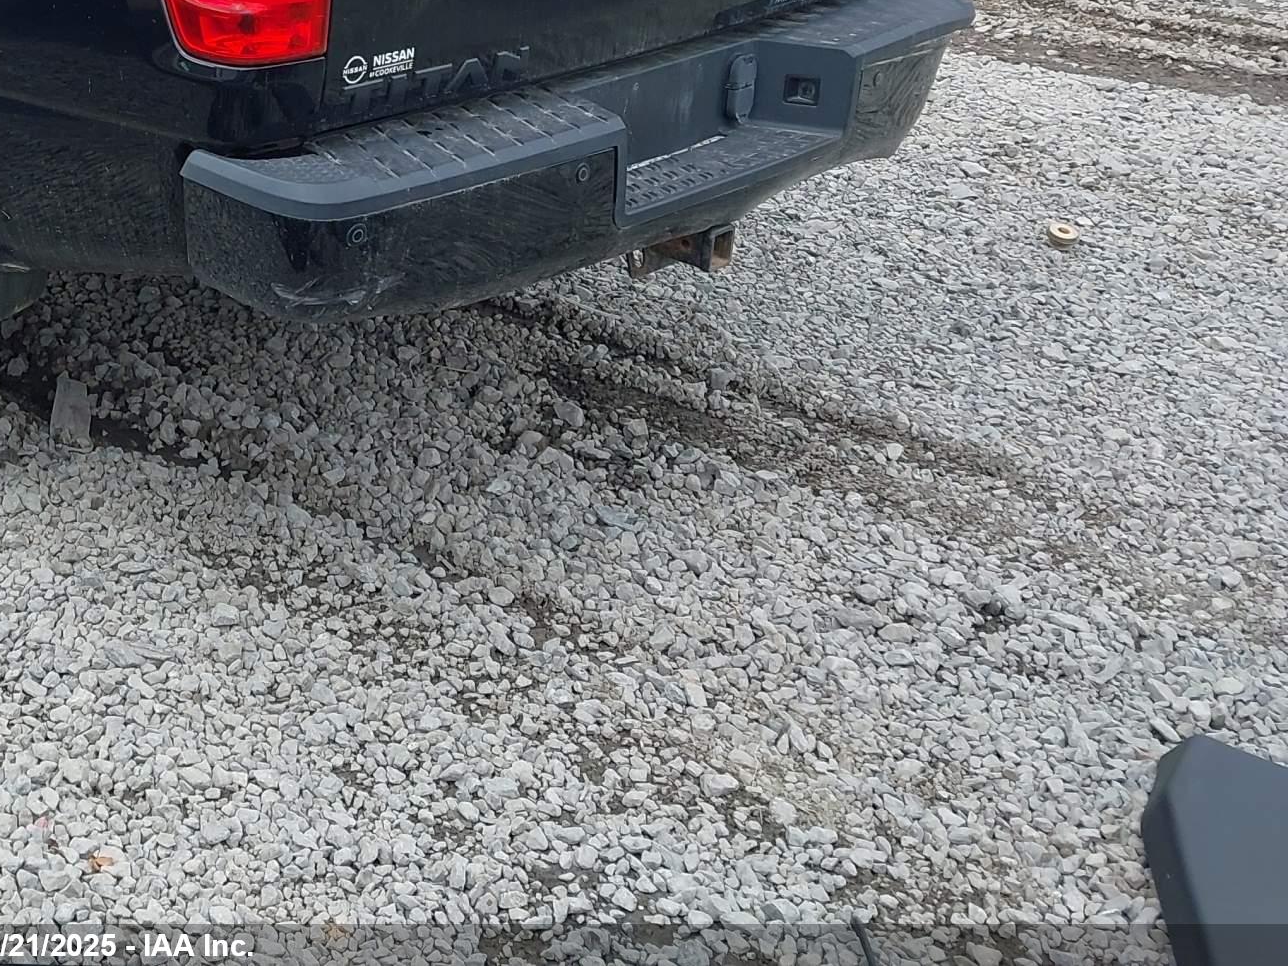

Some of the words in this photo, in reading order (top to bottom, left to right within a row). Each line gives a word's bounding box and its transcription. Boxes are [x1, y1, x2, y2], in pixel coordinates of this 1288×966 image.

[373, 47, 415, 67] NISSAN
[343, 64, 368, 75] NISSAN
[342, 46, 530, 114] TITAN
